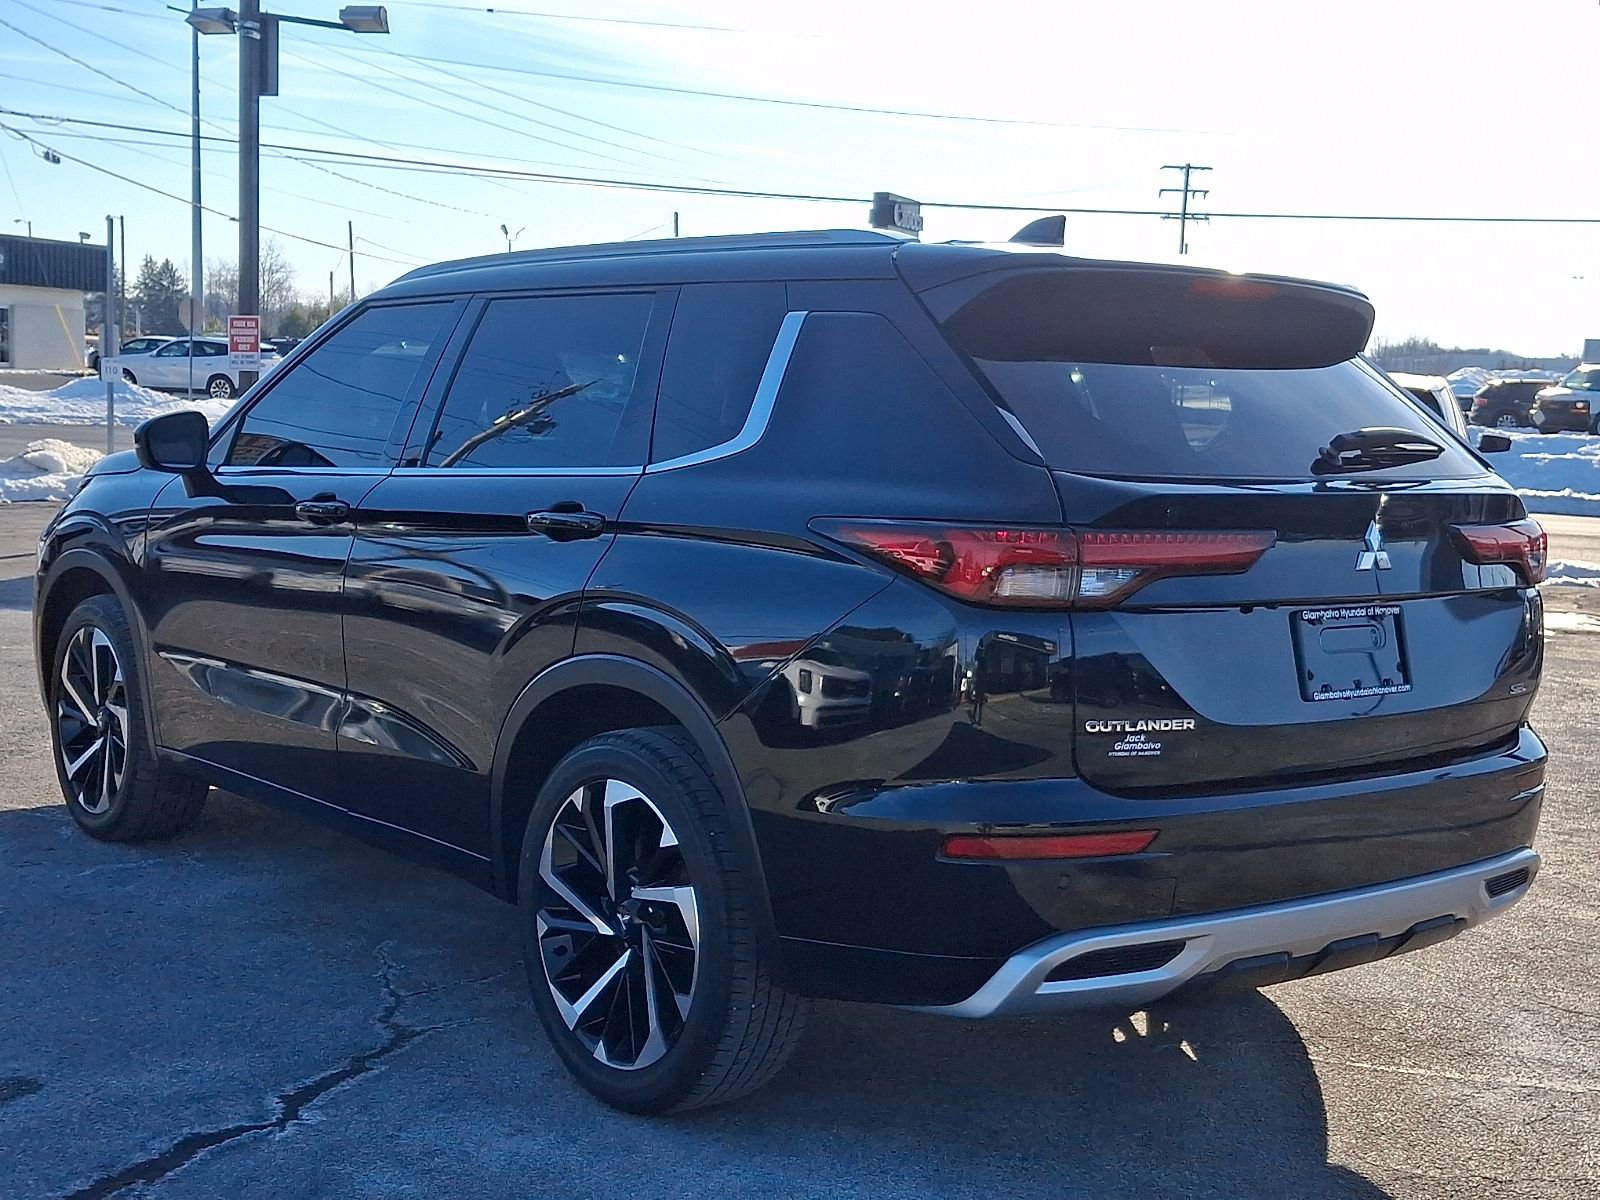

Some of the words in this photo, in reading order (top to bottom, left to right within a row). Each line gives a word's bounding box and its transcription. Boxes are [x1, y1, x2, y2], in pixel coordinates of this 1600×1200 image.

[1340, 607, 1366, 619] Hyundai
[1367, 607, 1374, 616] of
[1085, 719, 1195, 732] OUTLANDER
[1124, 734, 1146, 742] Jack
[1114, 741, 1161, 751] Giambalvo
